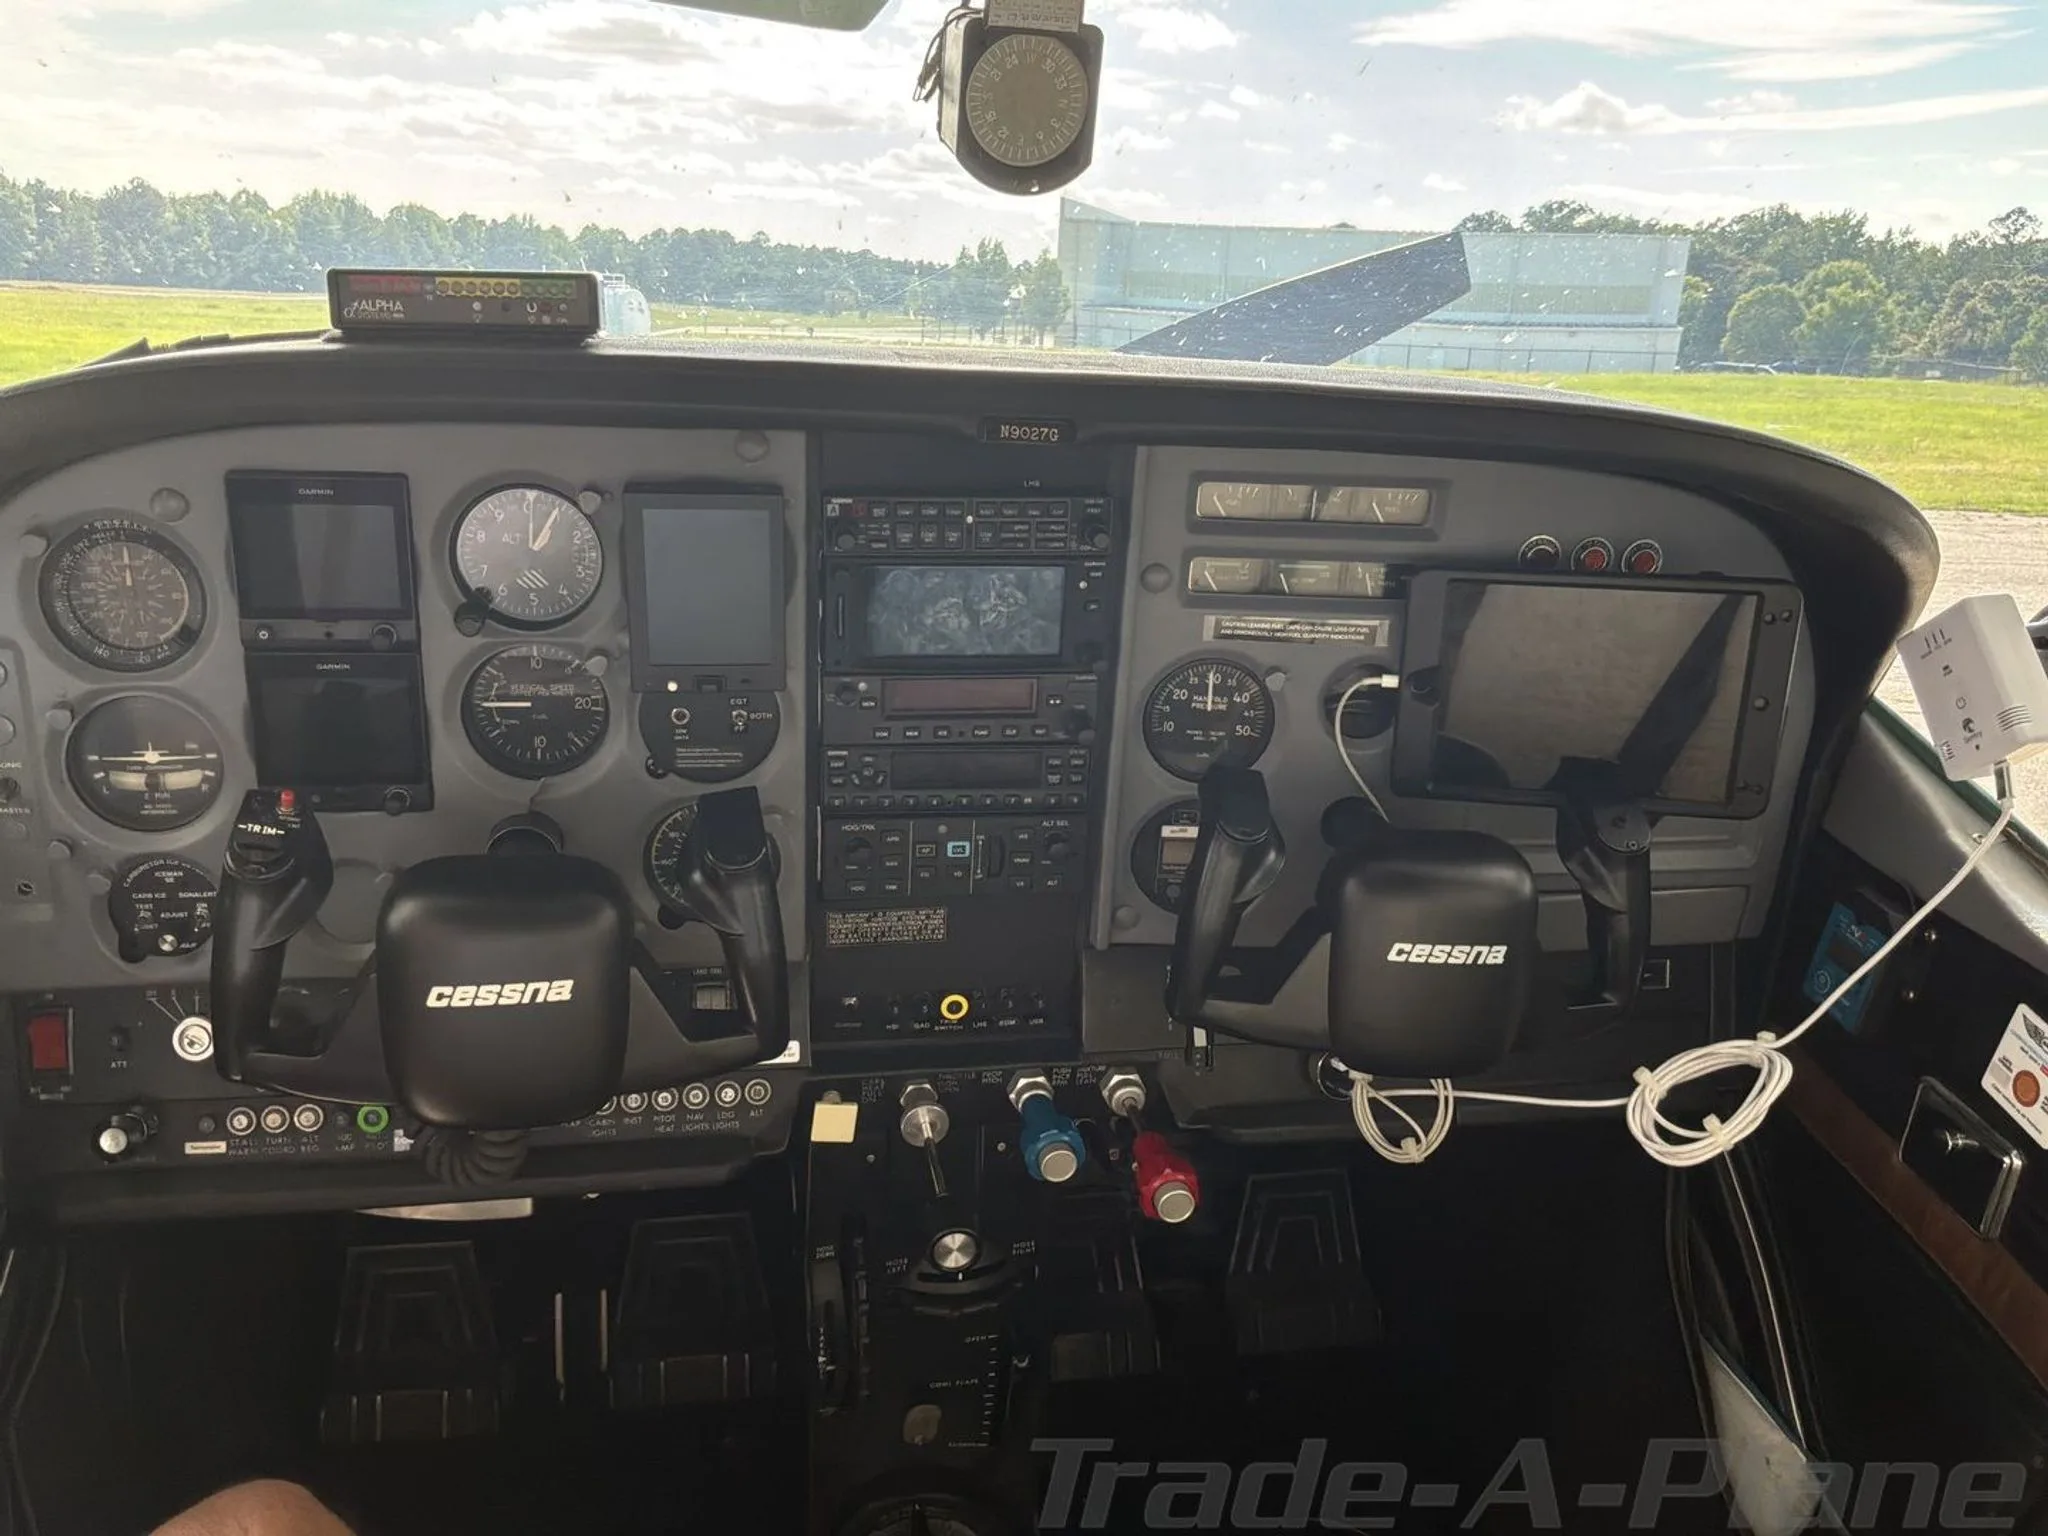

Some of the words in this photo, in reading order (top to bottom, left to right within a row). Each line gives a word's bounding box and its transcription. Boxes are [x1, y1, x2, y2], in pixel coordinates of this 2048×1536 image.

[360, 299, 404, 311] ALPHA
[1000, 423, 1060, 442] N9027G
[299, 488, 334, 496] GARMIN
[476, 530, 487, 542] 8
[502, 532, 522, 545] ALT
[573, 530, 582, 544] 2
[478, 564, 488, 577] 7
[575, 565, 585, 578] 3
[498, 583, 508, 596] 6
[559, 583, 568, 595] 4
[528, 591, 540, 605] 5
[316, 662, 351, 670] GARMIN
[530, 657, 543, 669] 10
[1173, 689, 1188, 700] 20
[1233, 692, 1250, 703] 40
[574, 697, 591, 709] 20
[1191, 702, 1227, 711] PRESURE
[1163, 721, 1175, 732] 10
[1235, 725, 1251, 736] 50
[534, 736, 546, 748] 10
[1386, 942, 1508, 966] cessna
[425, 979, 574, 1008] cessna
[110, 1060, 128, 1069] ATT
[686, 1113, 704, 1121] NAV
[717, 1111, 735, 1119] LDG
[750, 1109, 765, 1117] ALT
[655, 1125, 675, 1133] HEAT
[681, 1123, 710, 1131] LIGHTS
[713, 1121, 740, 1130] LIGHTS
